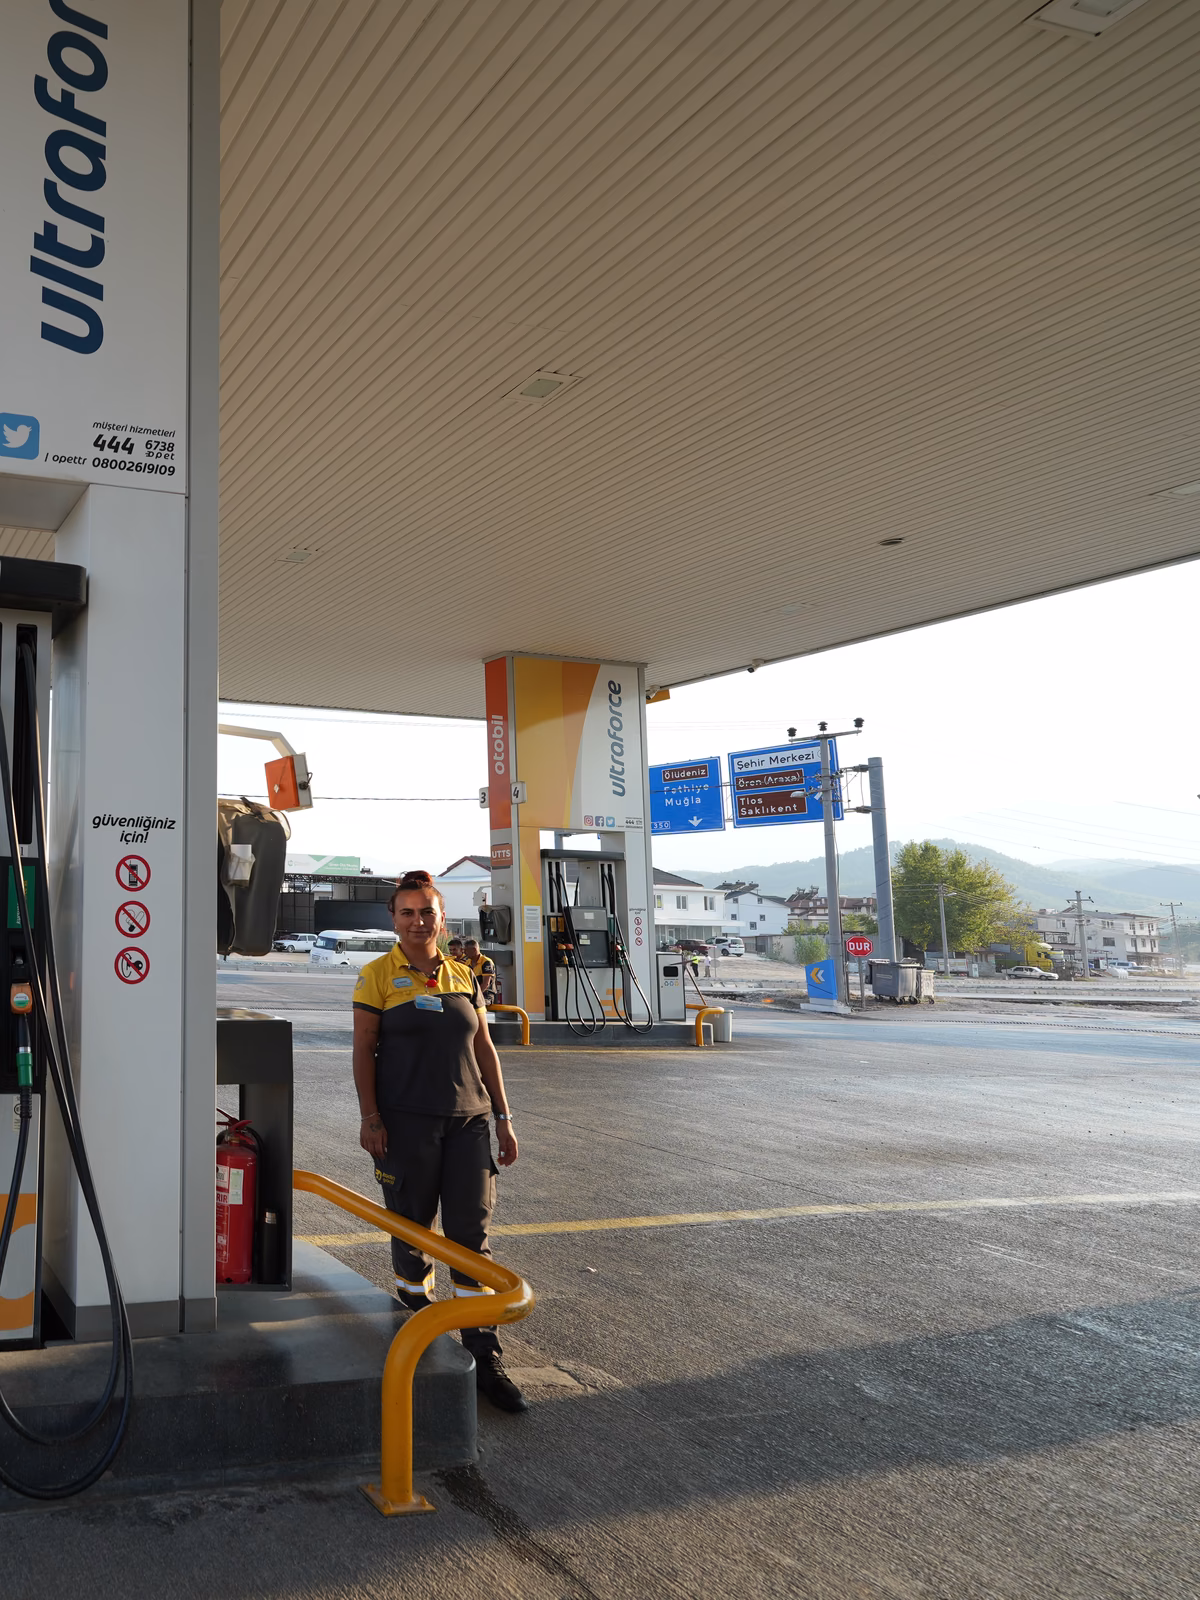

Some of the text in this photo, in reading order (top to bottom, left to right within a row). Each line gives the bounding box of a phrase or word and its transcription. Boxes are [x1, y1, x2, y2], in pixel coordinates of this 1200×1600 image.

[92, 421, 176, 438] müşteri hizmetleri
[92, 433, 175, 455] 444 6738
[52, 454, 87, 465] opettr
[92, 457, 176, 476] 08002619109
[491, 715, 505, 775] otobil
[607, 680, 626, 797] ultraforce
[737, 750, 815, 770] Şehir Merkezi
[480, 792, 487, 803] 3
[512, 786, 520, 799] 4
[665, 796, 702, 807] Muğla
[740, 797, 763, 806] Tlos
[740, 803, 798, 816] Saklıkent
[92, 814, 176, 832] güvenliğiniz
[119, 830, 149, 845] için!
[491, 849, 511, 859] UTTS
[849, 941, 871, 951] DUR
